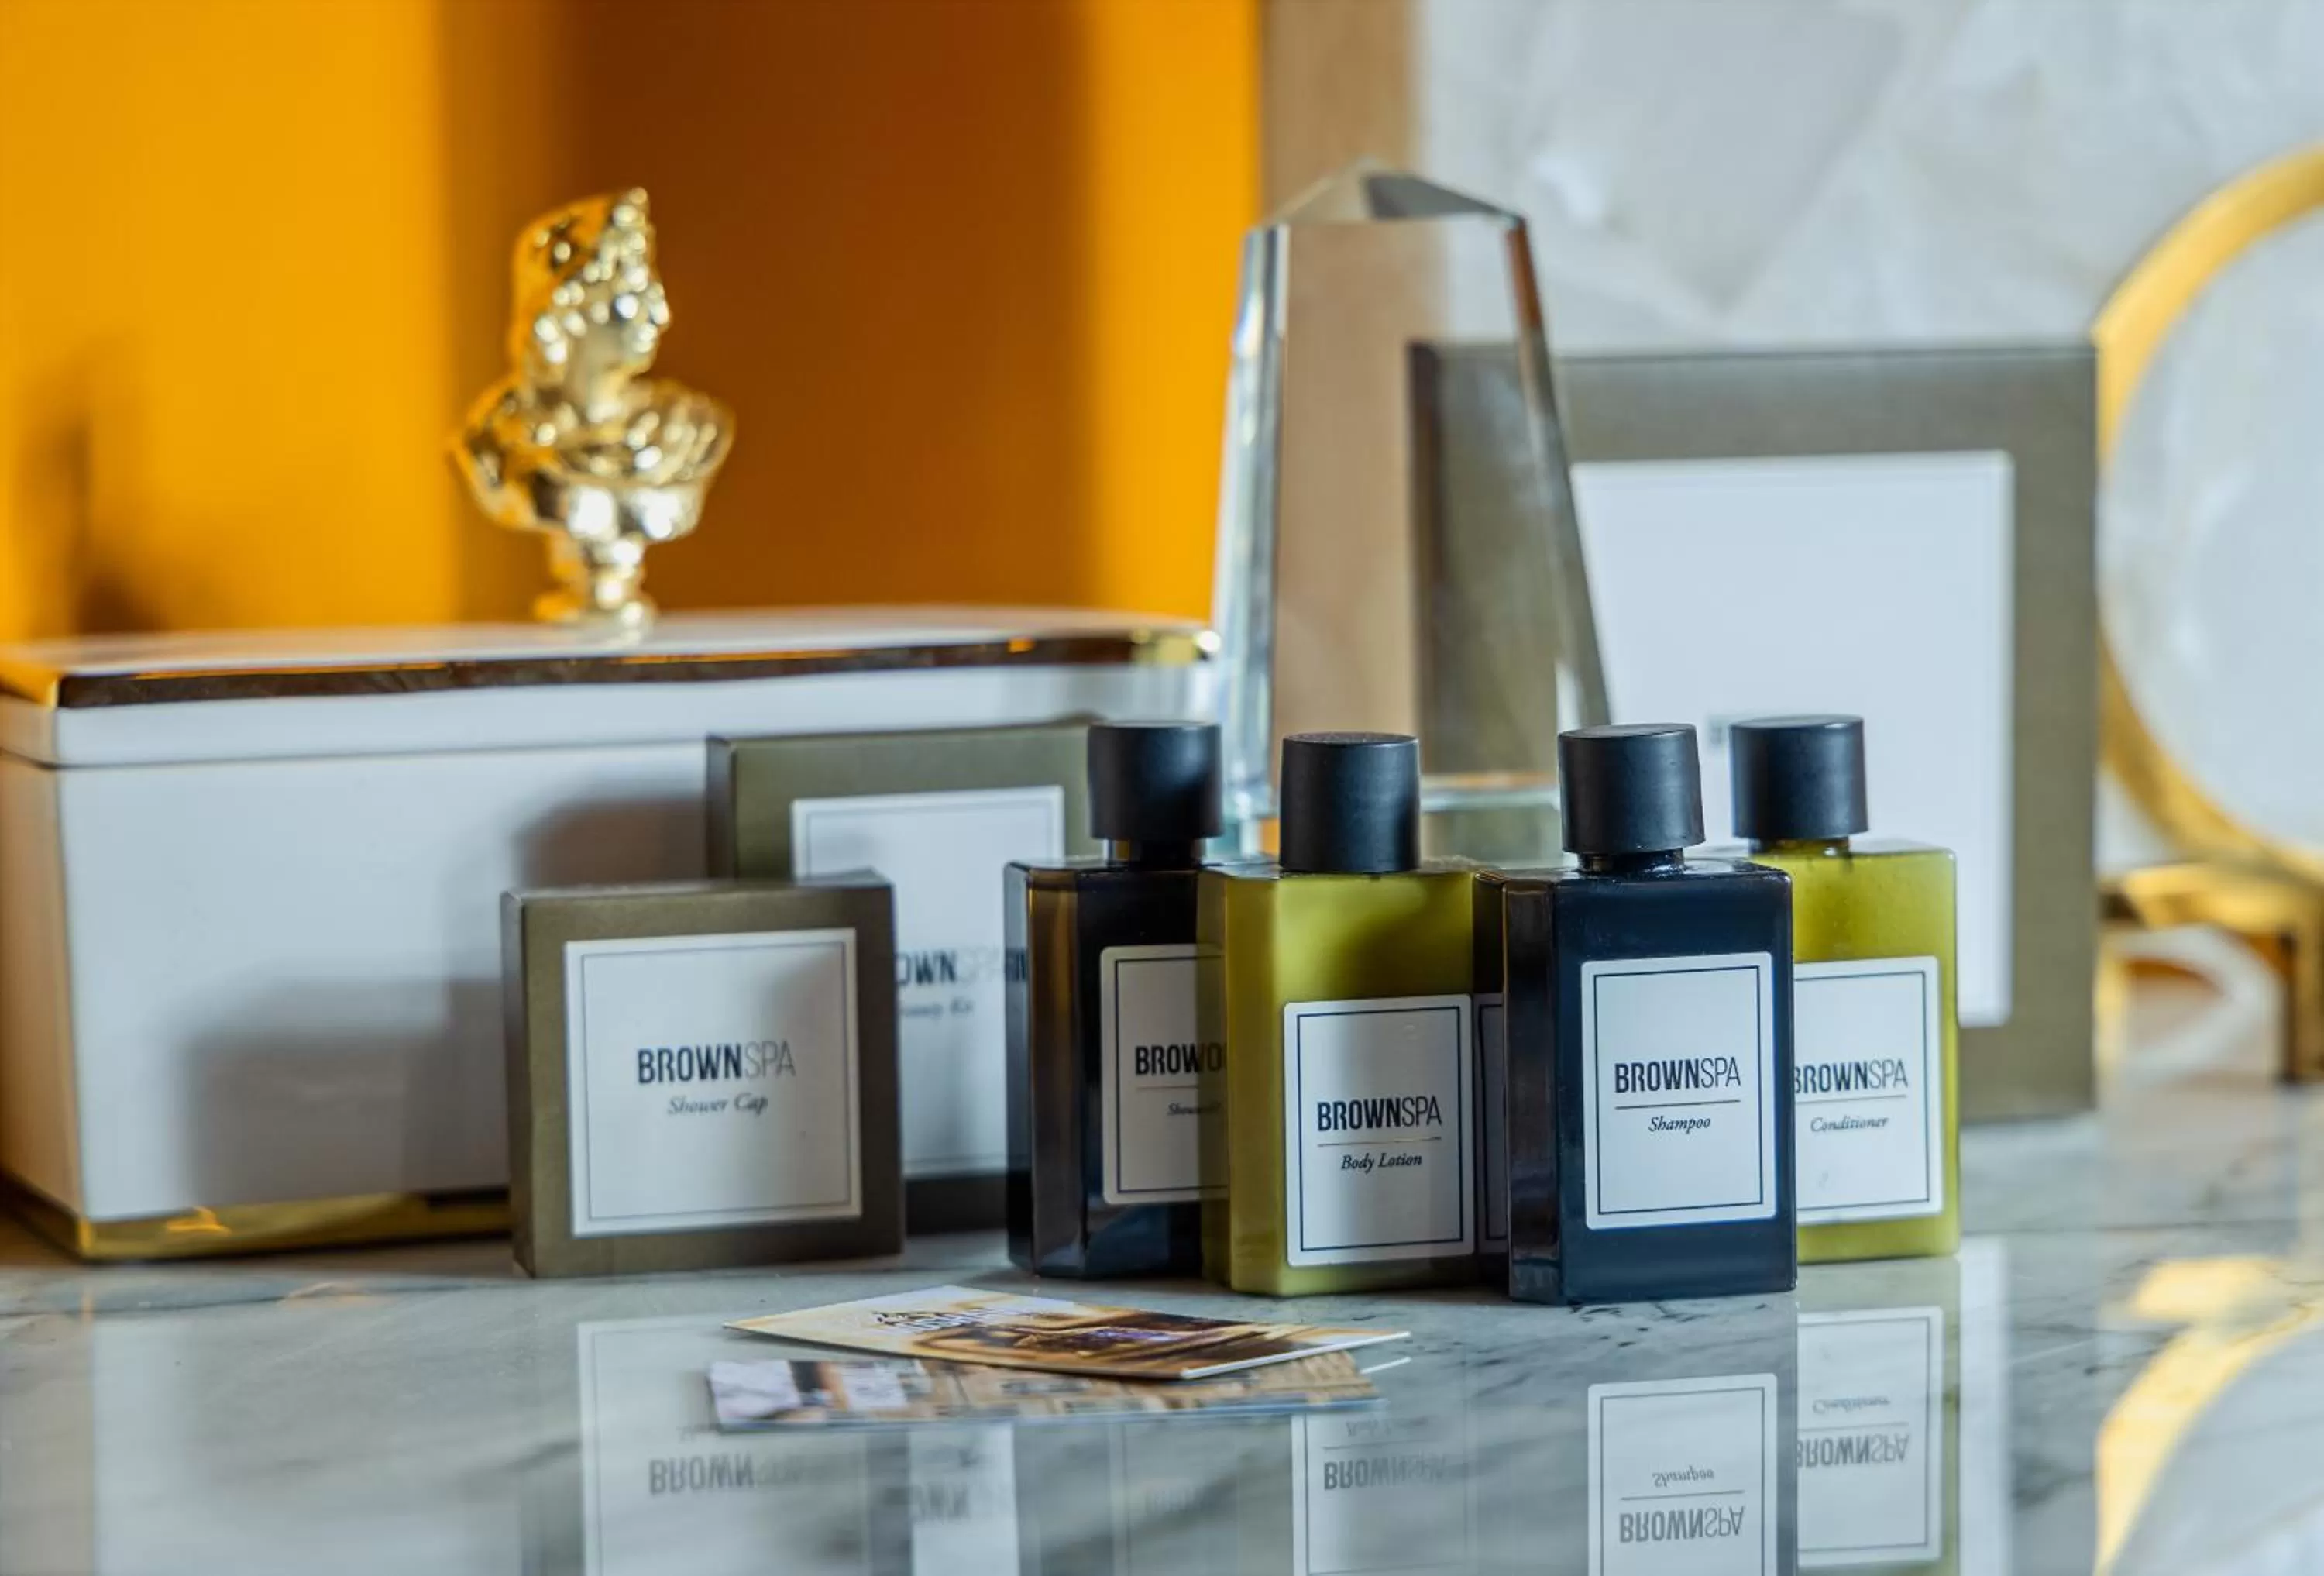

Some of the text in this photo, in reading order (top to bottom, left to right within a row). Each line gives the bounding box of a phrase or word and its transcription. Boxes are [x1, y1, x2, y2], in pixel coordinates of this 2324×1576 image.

[638, 1039, 796, 1085] BROWNSPA
[1614, 1055, 1741, 1093] BROWNSPA
[667, 1092, 769, 1117] Shower Cap
[1317, 1095, 1442, 1131] BROWNSPA
[1648, 1115, 1711, 1134] Shampoo
[1810, 1115, 1890, 1133] Conditioner
[1341, 1151, 1422, 1174] Body Lotion
